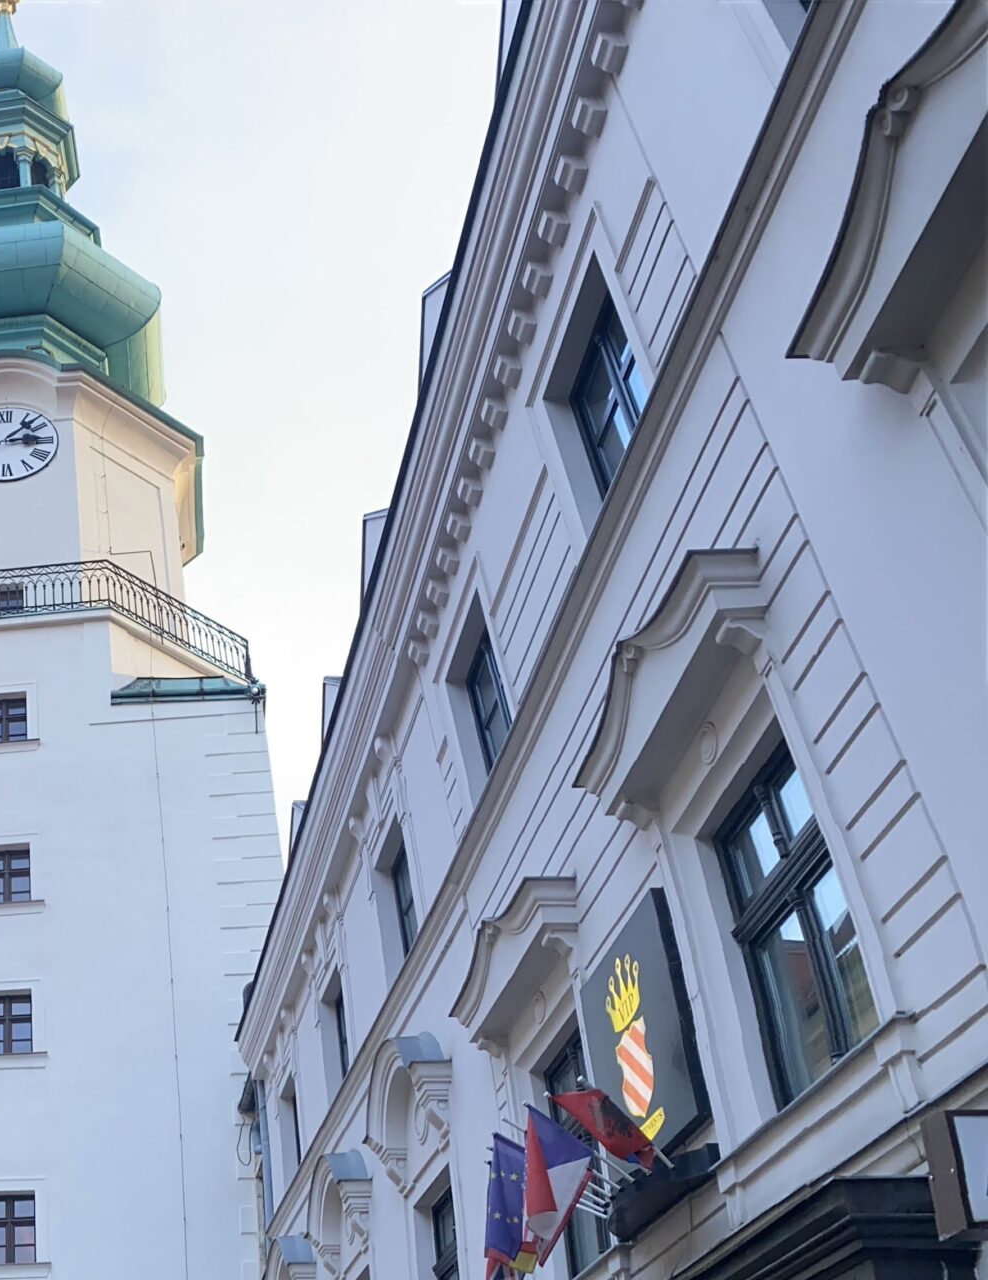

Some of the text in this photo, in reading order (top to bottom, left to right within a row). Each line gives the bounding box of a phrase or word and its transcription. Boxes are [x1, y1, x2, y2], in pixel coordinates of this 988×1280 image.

[1, 463, 14, 477] VI
[20, 459, 35, 472] V
[618, 992, 634, 1022] VIP
